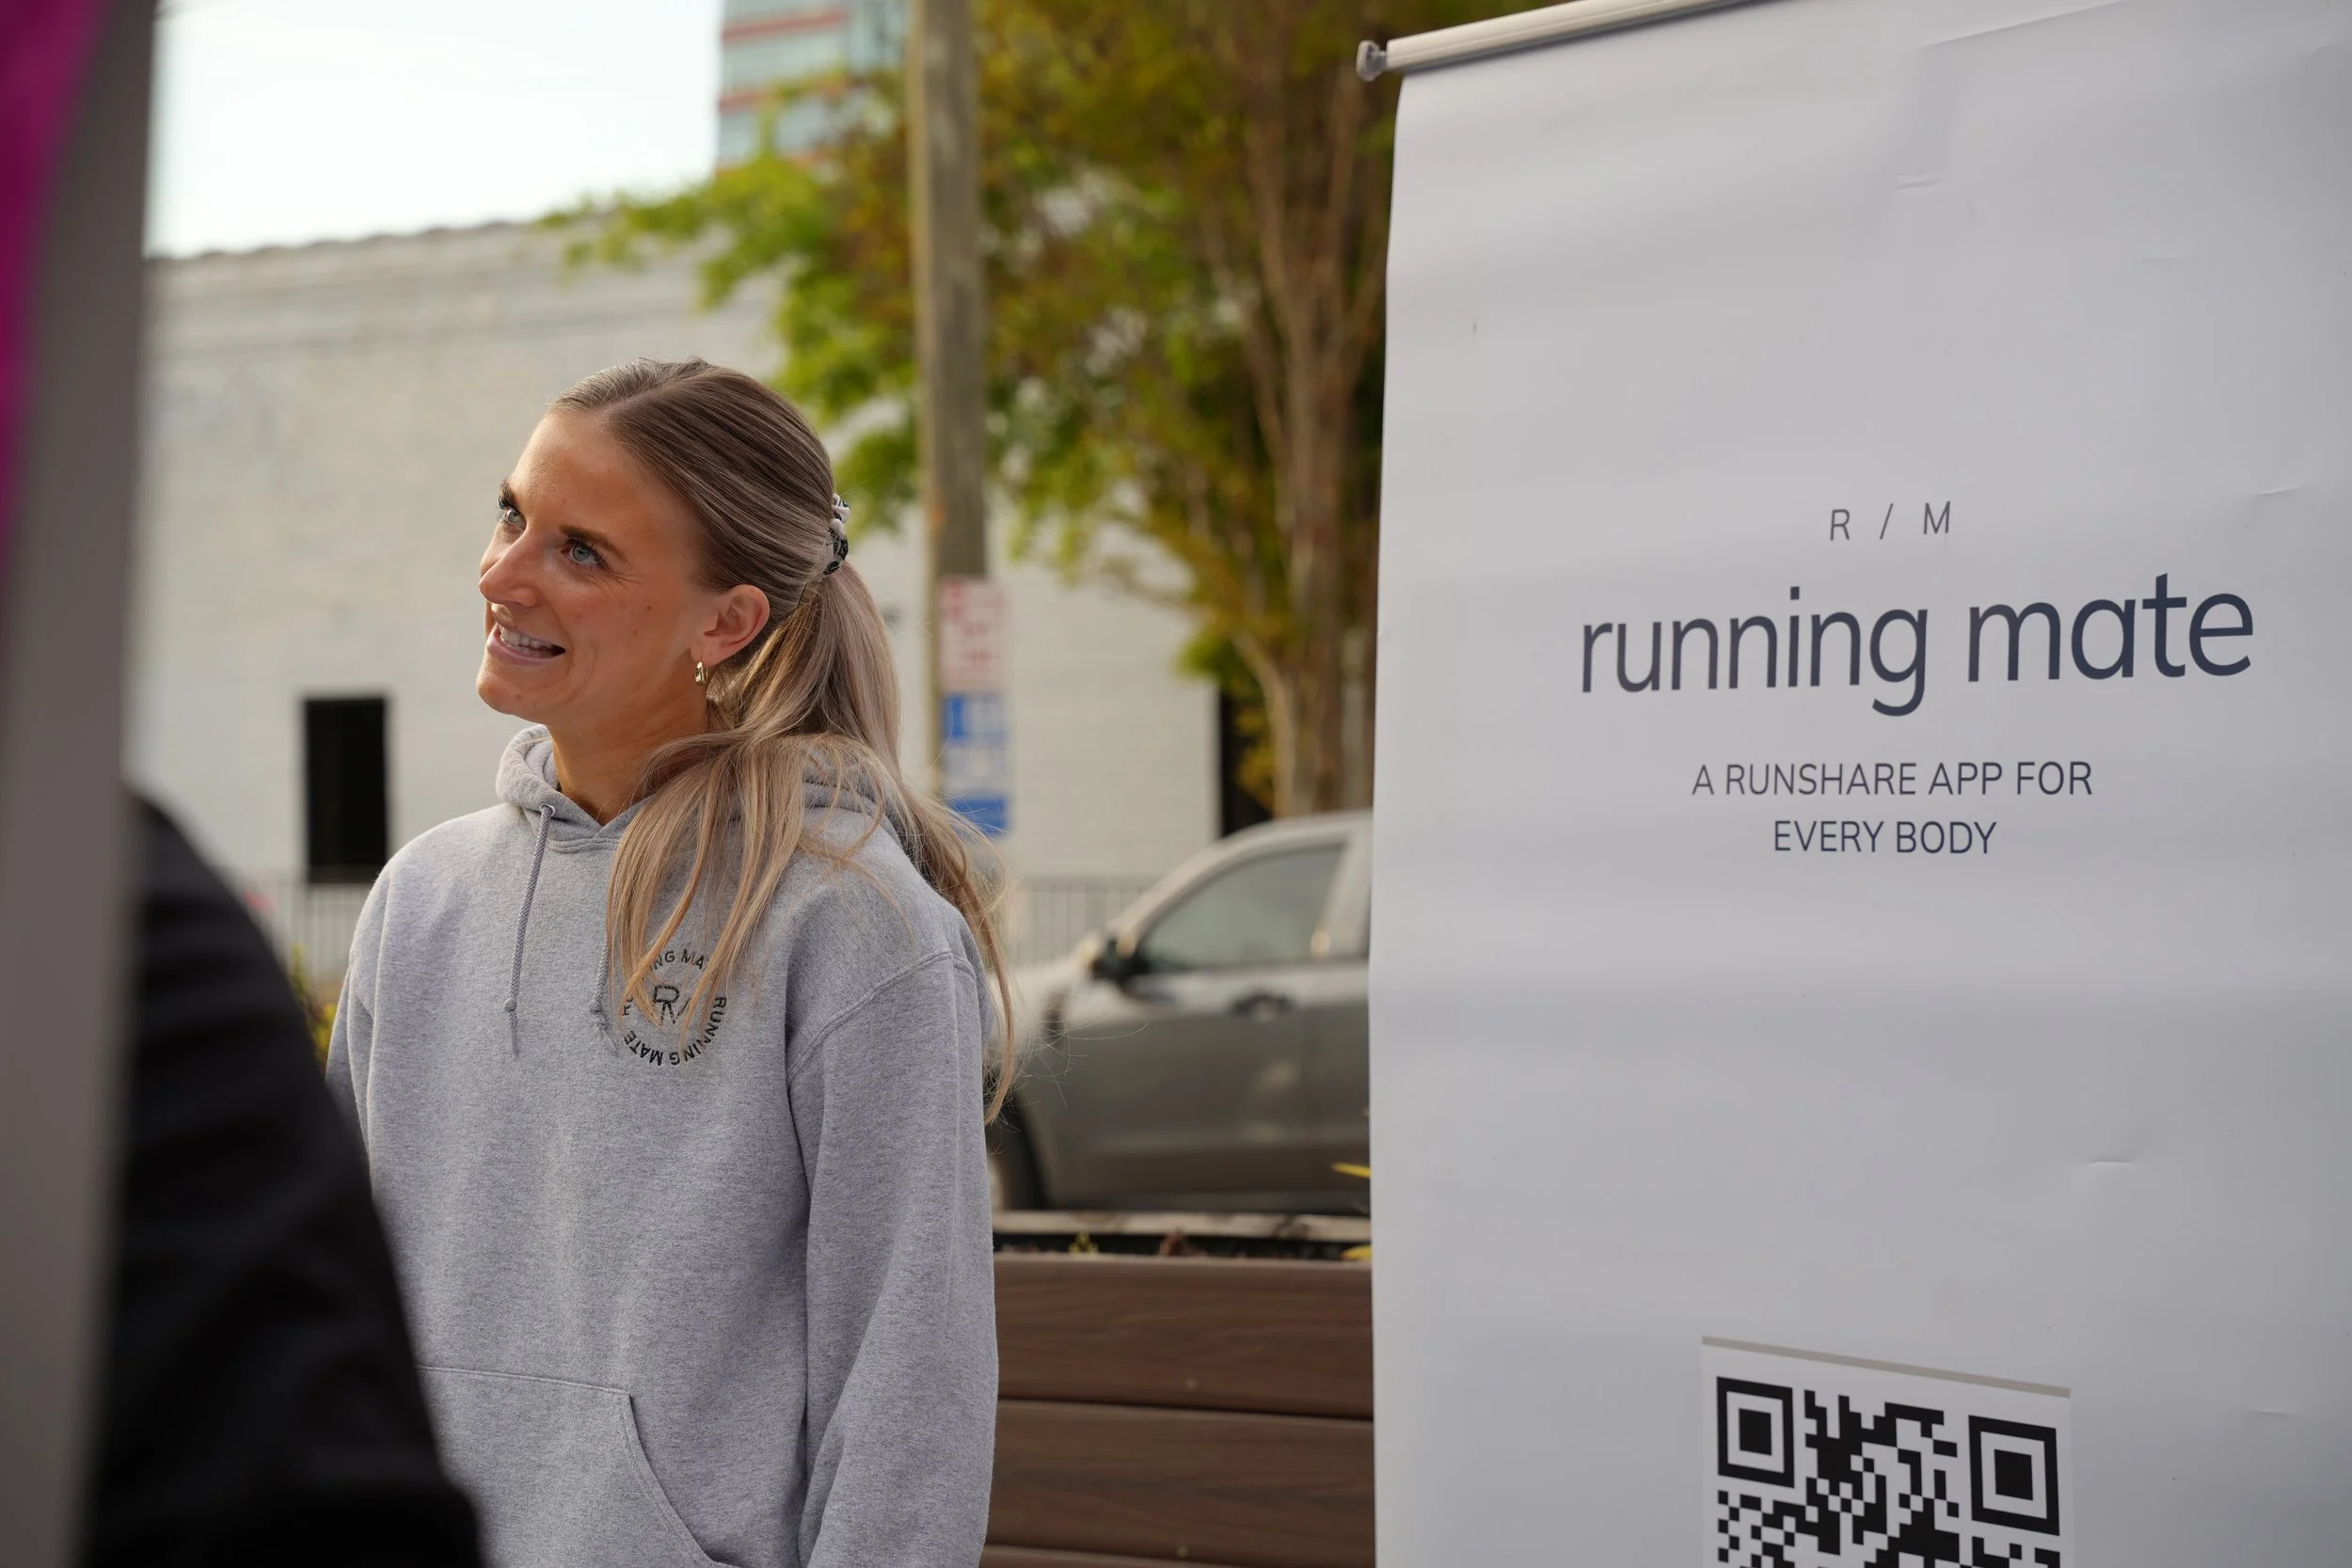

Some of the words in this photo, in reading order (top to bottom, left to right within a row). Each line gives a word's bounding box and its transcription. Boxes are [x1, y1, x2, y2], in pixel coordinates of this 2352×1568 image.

[1829, 508, 1851, 542] R
[1922, 500, 1952, 535] M
[1581, 585, 1929, 718] running
[1967, 572, 2254, 684] mate
[1691, 764, 1715, 796] A
[1724, 762, 1918, 797] RUNSHARE
[1927, 761, 2004, 797] APP
[2015, 760, 2093, 796] FOR
[1773, 819, 1885, 853] EVERY
[1895, 820, 1998, 855] BODY
[623, 1030, 664, 1066] MATE
